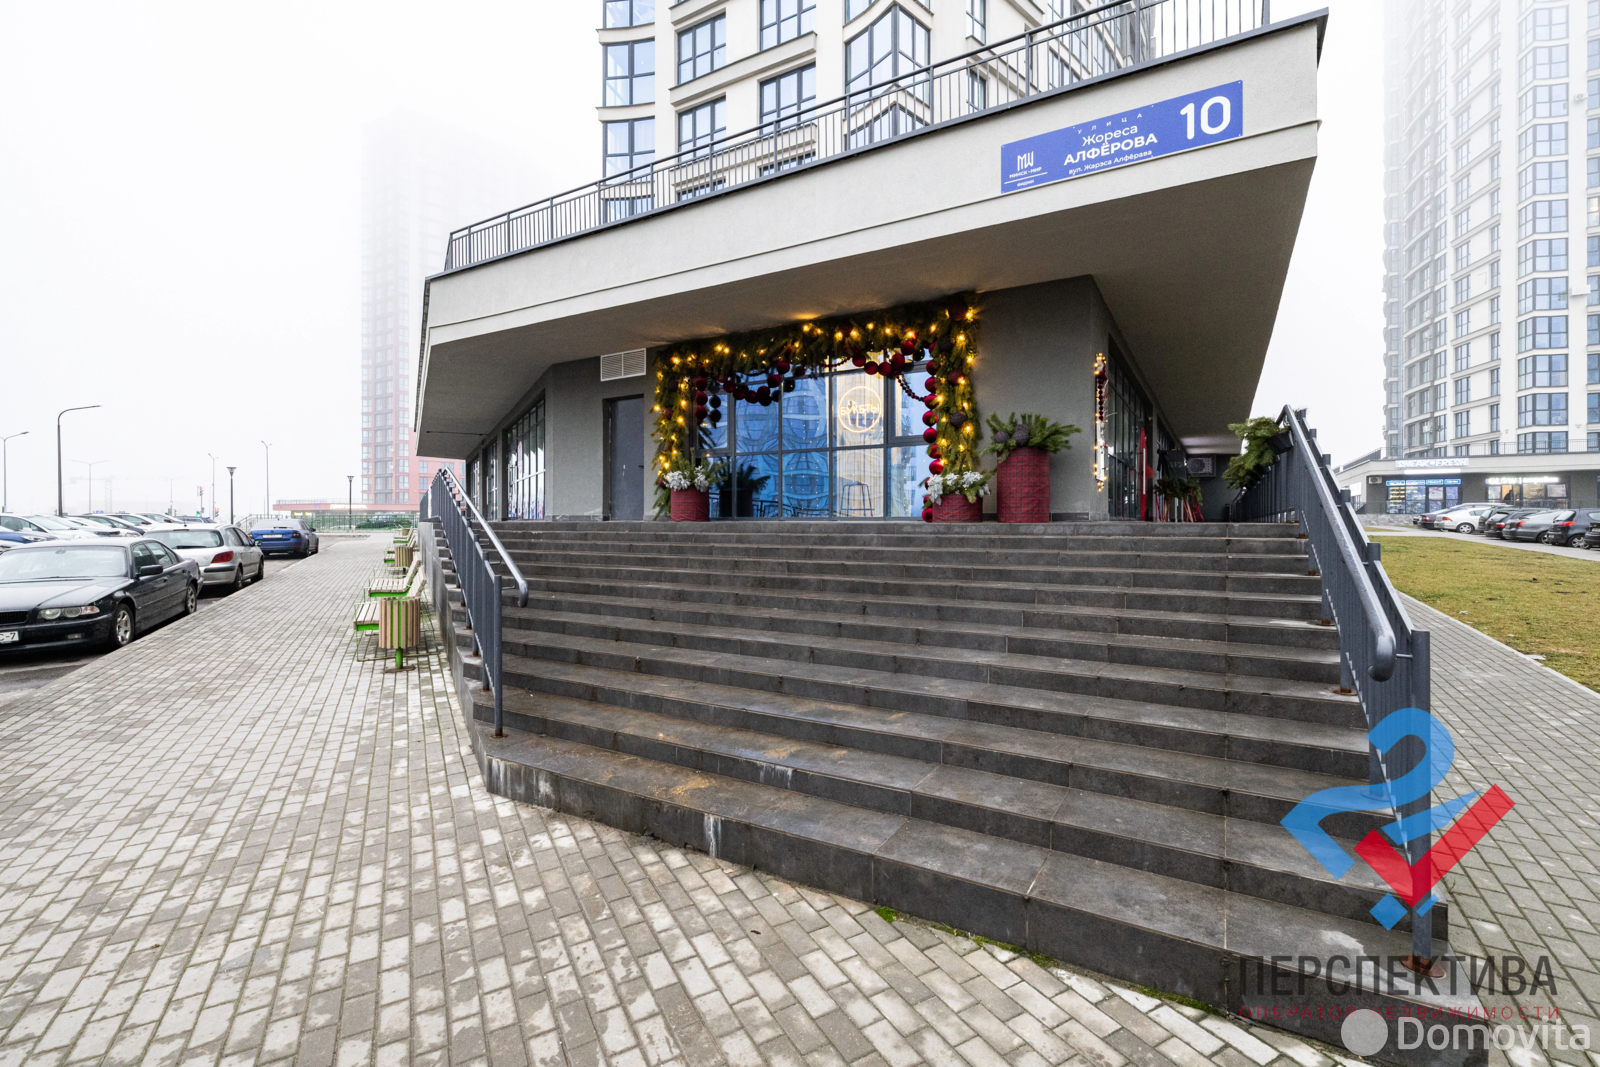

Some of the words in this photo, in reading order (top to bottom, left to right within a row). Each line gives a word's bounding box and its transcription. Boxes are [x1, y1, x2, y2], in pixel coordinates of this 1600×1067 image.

[1180, 95, 1231, 140] 10
[1063, 133, 1158, 166] АЛФЁРОВА
[1082, 125, 1138, 147] Жореса
[1068, 166, 1083, 176] вул.
[1084, 160, 1112, 171] Жарэса
[1113, 150, 1153, 164] Алфёрава
